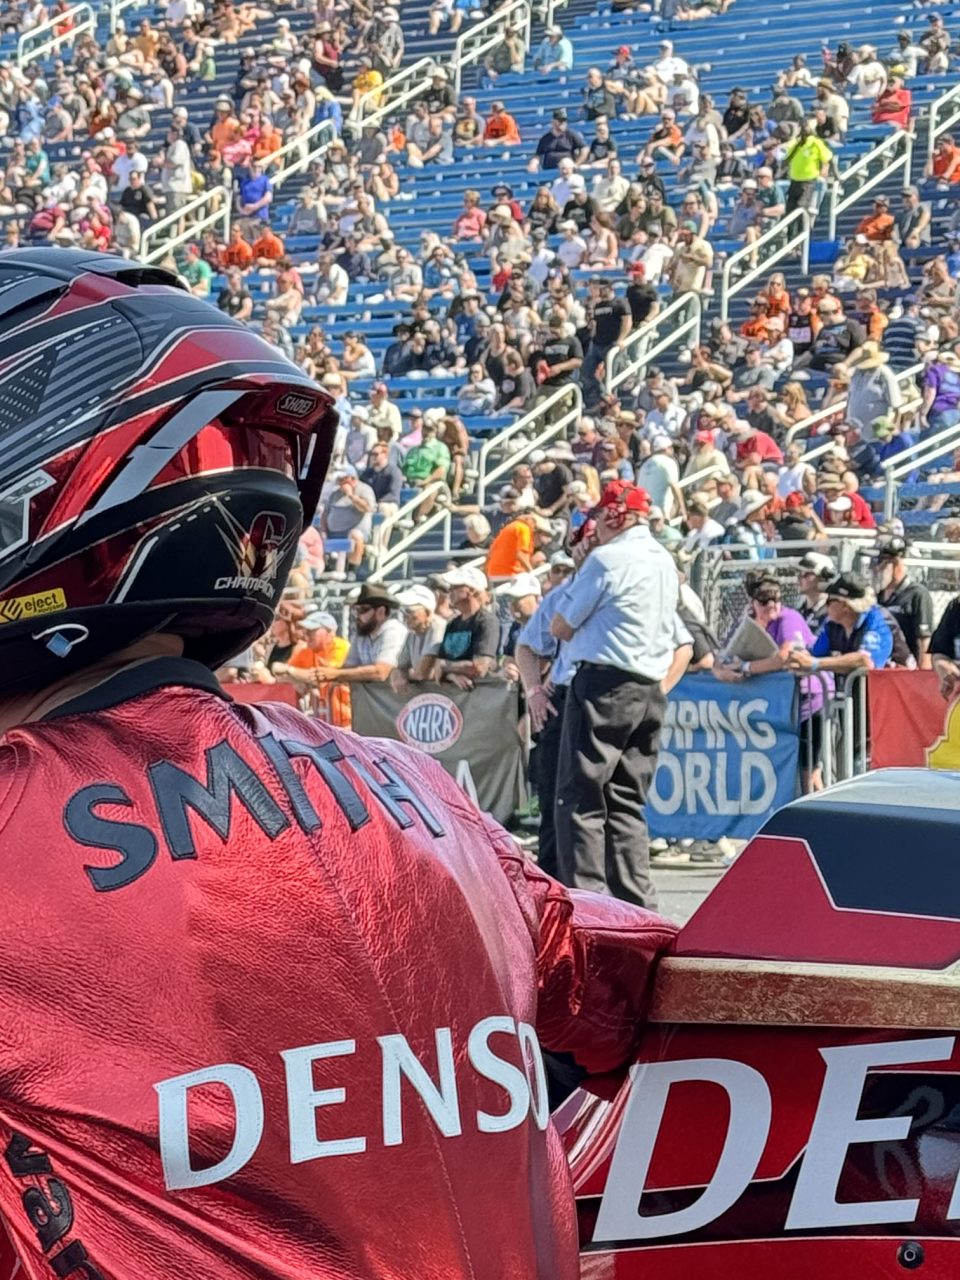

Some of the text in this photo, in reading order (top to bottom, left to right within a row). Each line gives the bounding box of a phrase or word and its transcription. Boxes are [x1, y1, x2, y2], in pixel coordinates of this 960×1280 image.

[24, 592, 58, 613] eject
[406, 705, 453, 741] NHRA
[62, 732, 445, 893] SMITH
[151, 1015, 549, 1191] DENSO
[591, 1036, 960, 1243] DE
